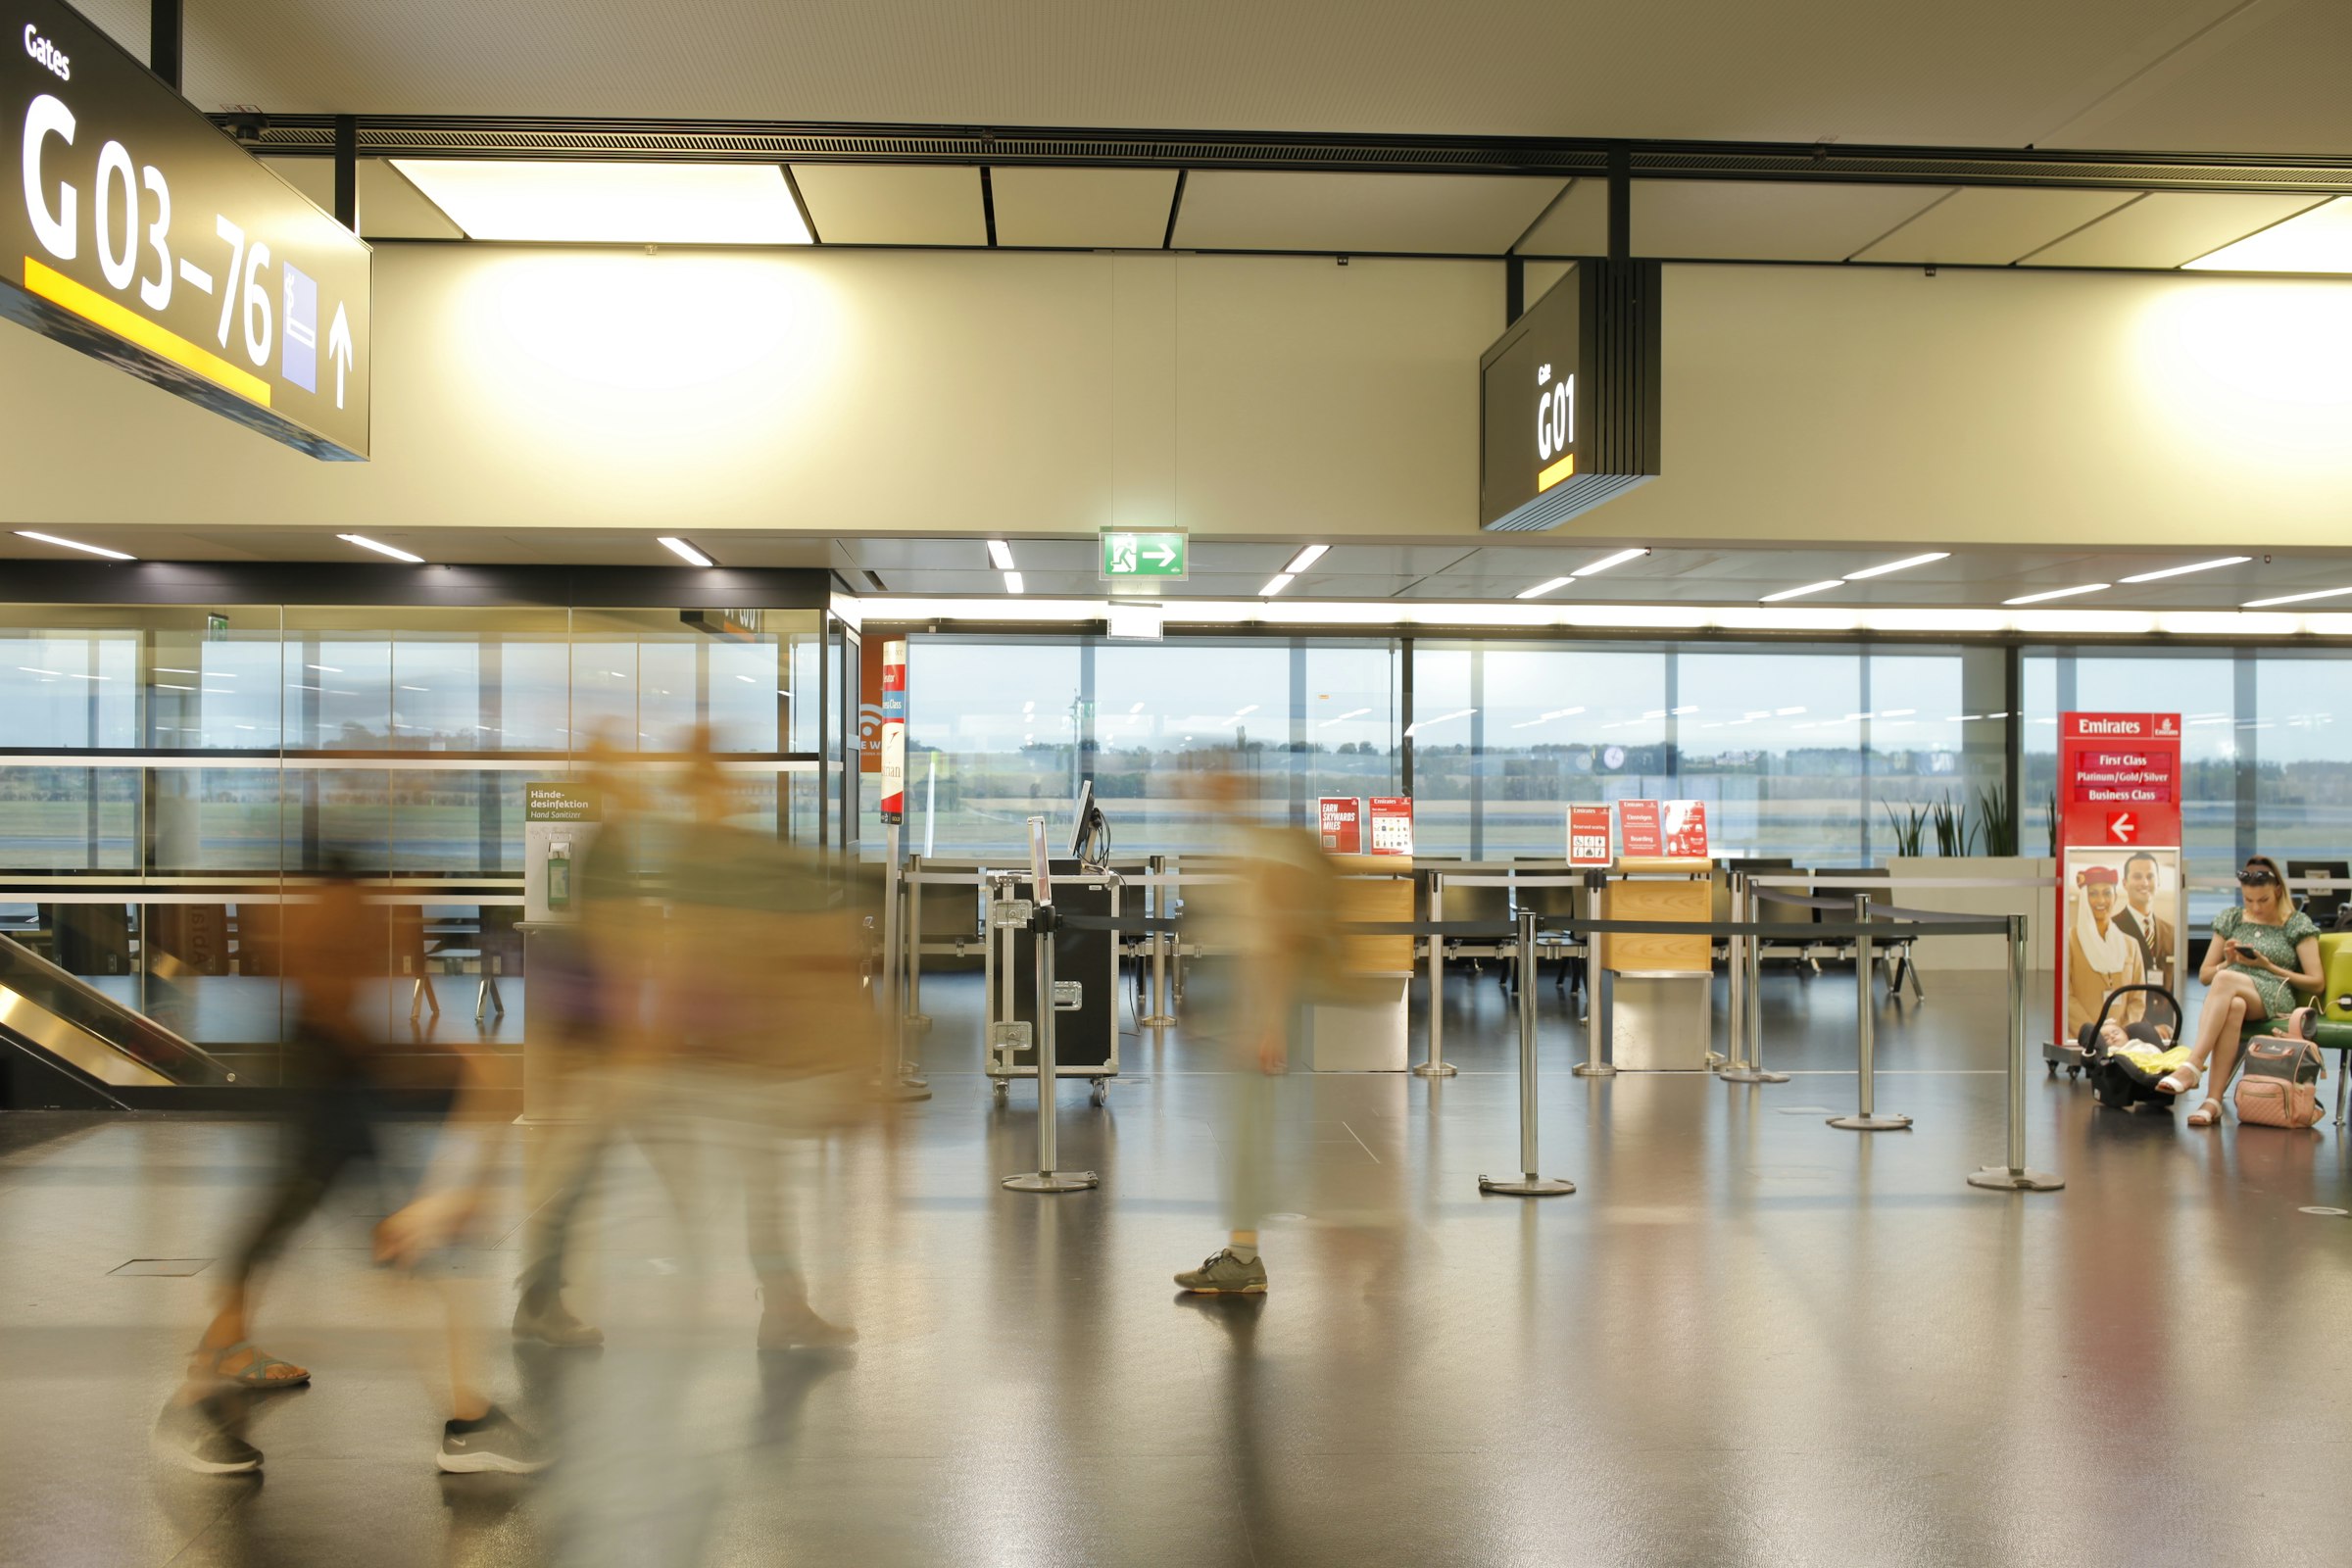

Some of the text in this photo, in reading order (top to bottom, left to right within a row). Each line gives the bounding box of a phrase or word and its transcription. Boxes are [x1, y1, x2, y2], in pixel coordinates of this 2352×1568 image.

[24, 24, 70, 80] Gates
[1538, 373, 1575, 461] G01
[2079, 718, 2140, 734] Emirates
[2099, 754, 2147, 765] First Class
[2078, 771, 2168, 783] Platinum/Gold/Silver
[531, 790, 564, 799] Hände-
[2089, 790, 2155, 801] Business Class
[531, 800, 588, 809] desinfektion
[1322, 804, 1338, 812] EARN
[1322, 812, 1355, 822] SKYWARDS
[1323, 821, 1341, 830] MILES
